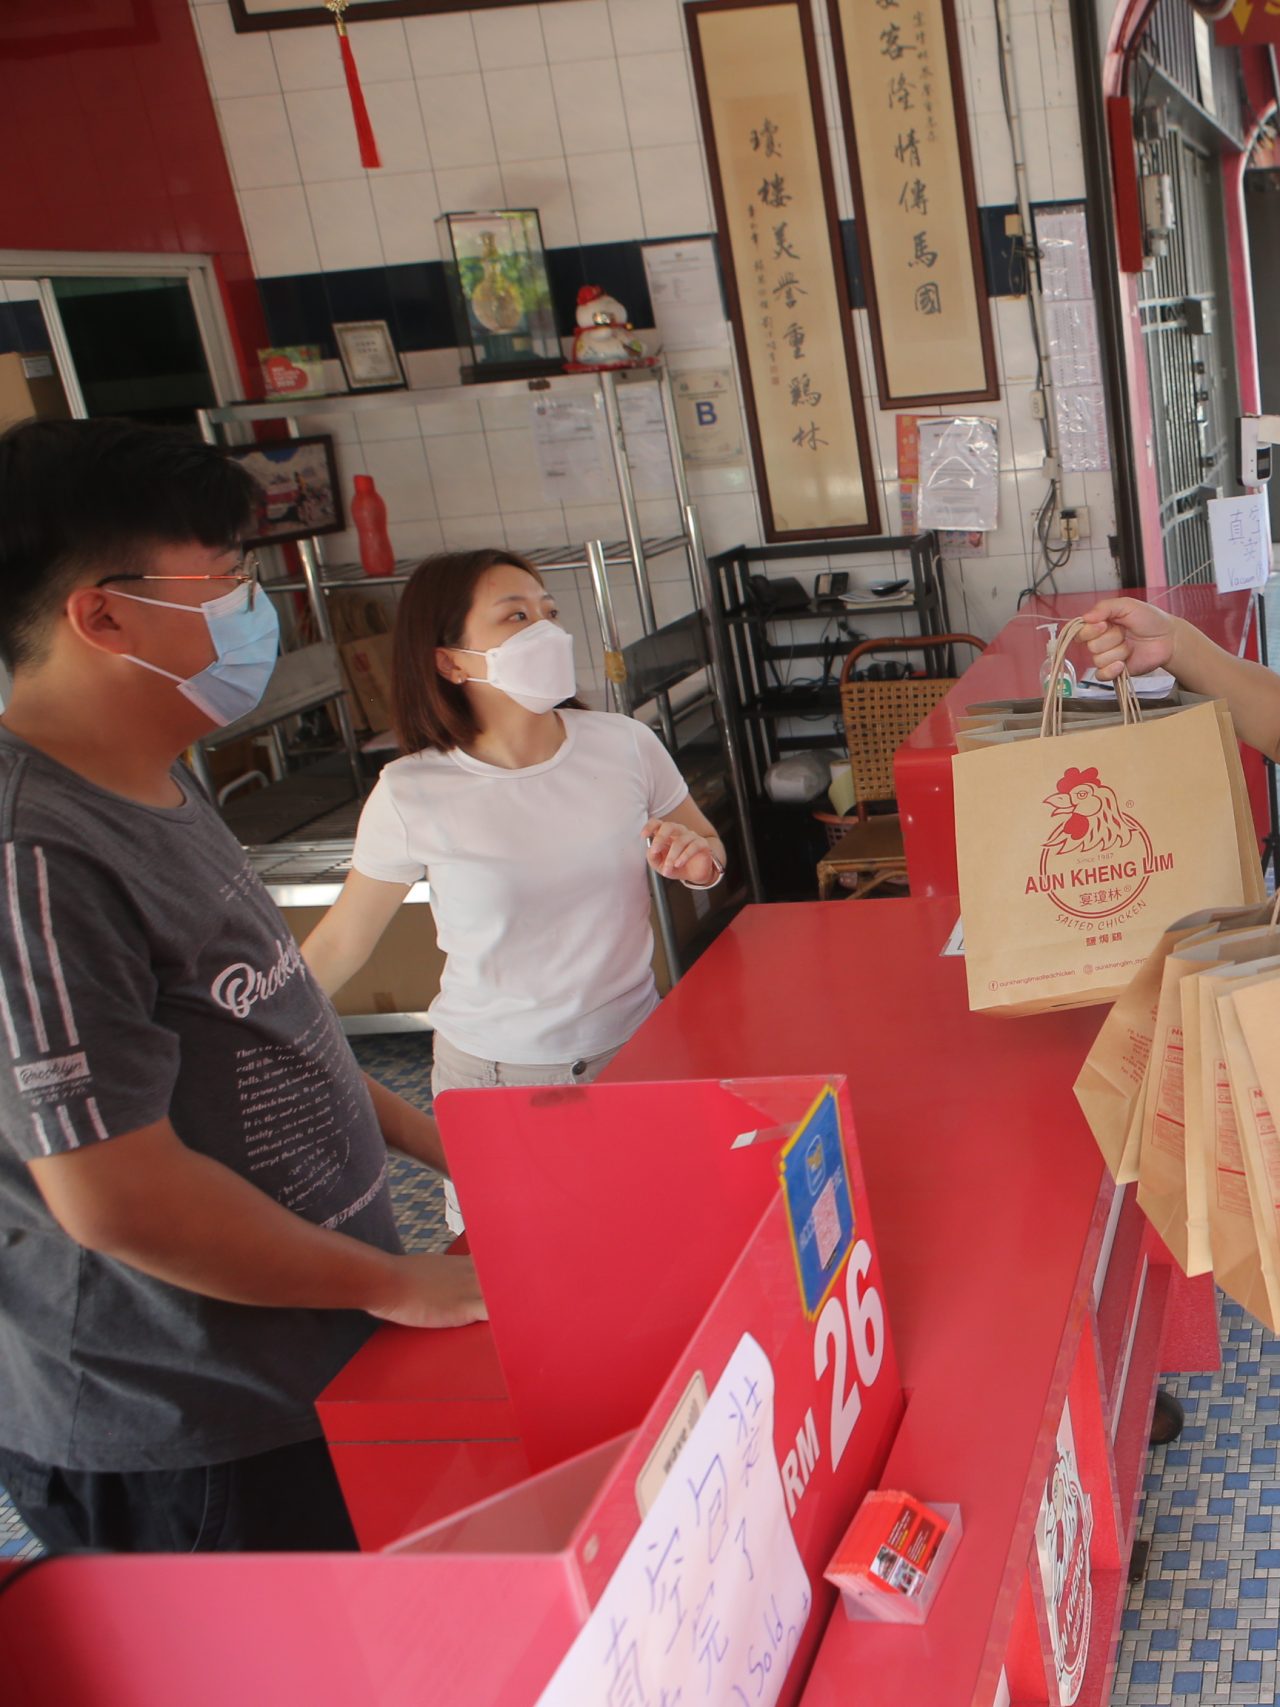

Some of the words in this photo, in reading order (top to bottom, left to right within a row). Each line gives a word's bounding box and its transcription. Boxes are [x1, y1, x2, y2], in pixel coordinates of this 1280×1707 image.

[1025, 872, 1065, 895] AUN
[1071, 860, 1137, 888] KHENG
[1142, 852, 1175, 875] LIM
[1055, 912, 1094, 932] SALTED
[1097, 899, 1148, 931] CHICKEN
[781, 1406, 821, 1519] RM
[813, 1238, 885, 1474] 26
